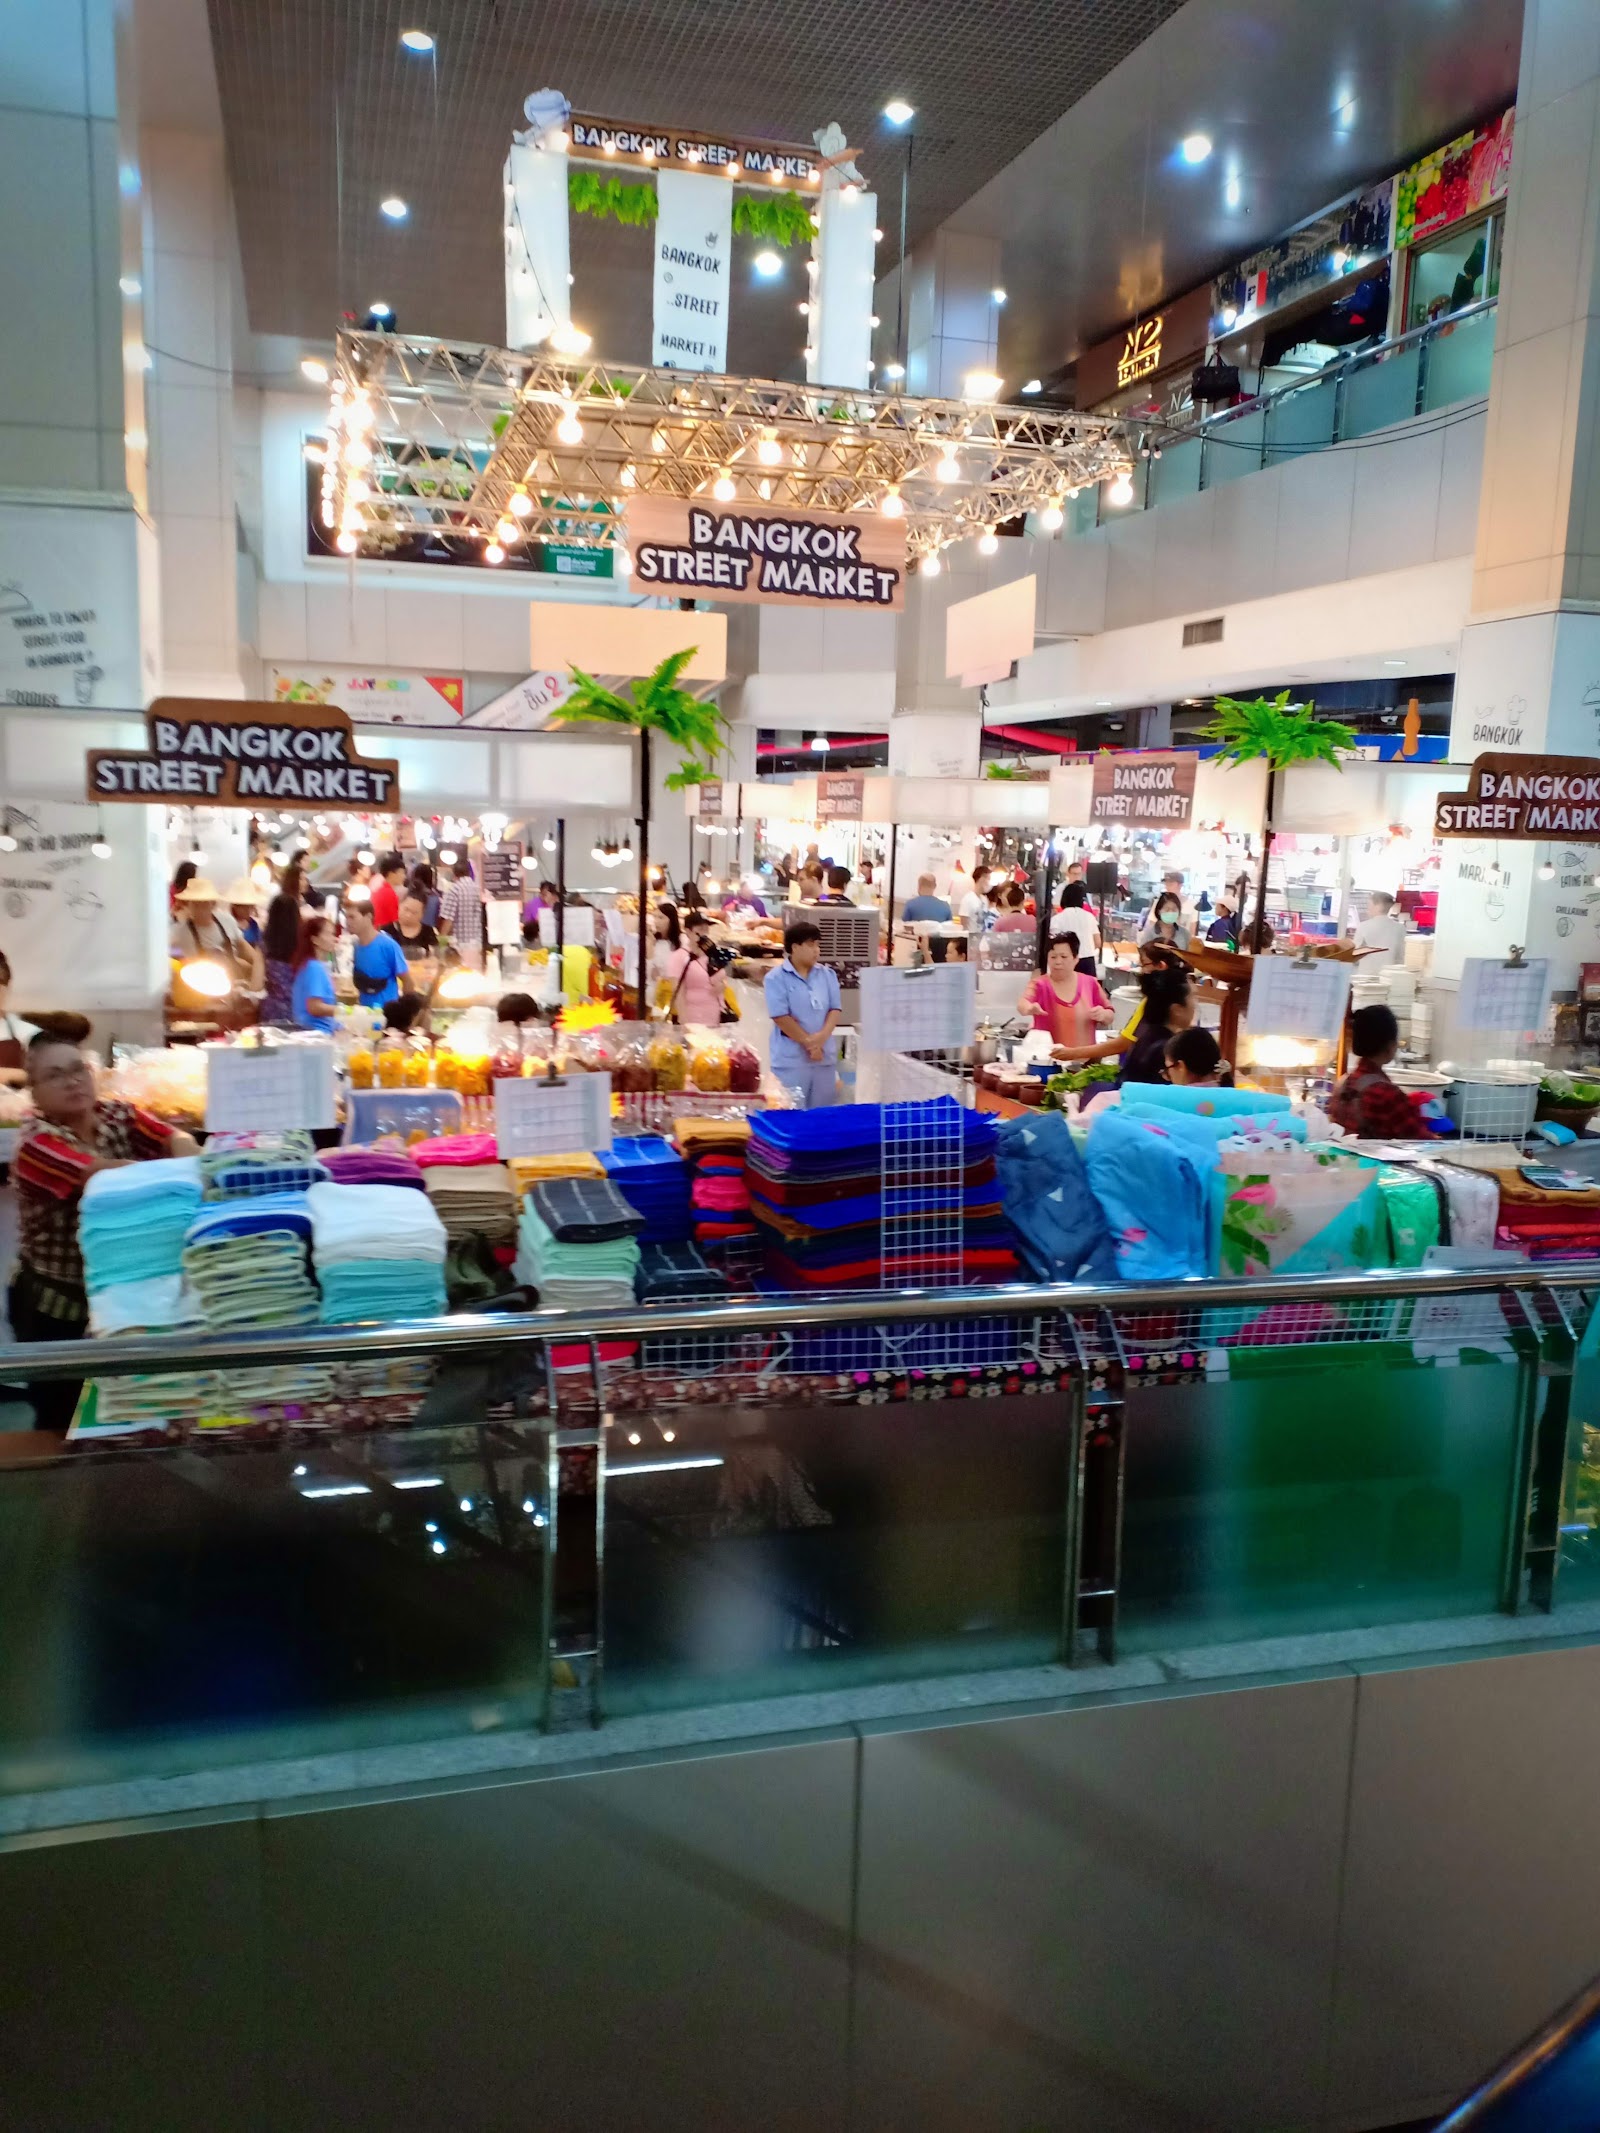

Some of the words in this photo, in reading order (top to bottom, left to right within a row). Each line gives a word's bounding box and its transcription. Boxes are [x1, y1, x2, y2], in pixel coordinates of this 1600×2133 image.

[572, 123, 670, 157] BANGKOK
[677, 140, 738, 167] STREET
[661, 244, 721, 275] BANGKOK
[660, 333, 706, 356] MARKET
[693, 512, 860, 560] BANGKOK
[639, 547, 749, 588] STREET
[762, 558, 896, 602] MARKET
[543, 675, 564, 699] 2
[155, 720, 347, 763] BANGKOK
[1472, 723, 1525, 746] BANGKOK
[95, 759, 224, 795] STREET
[237, 761, 393, 804] MARKET
[1113, 766, 1176, 790] BANGKOK
[1480, 773, 1600, 802] BANGKOK
[1094, 794, 1133, 817] STREET
[1135, 794, 1190, 819] MARKET
[1438, 804, 1520, 830] STREET
